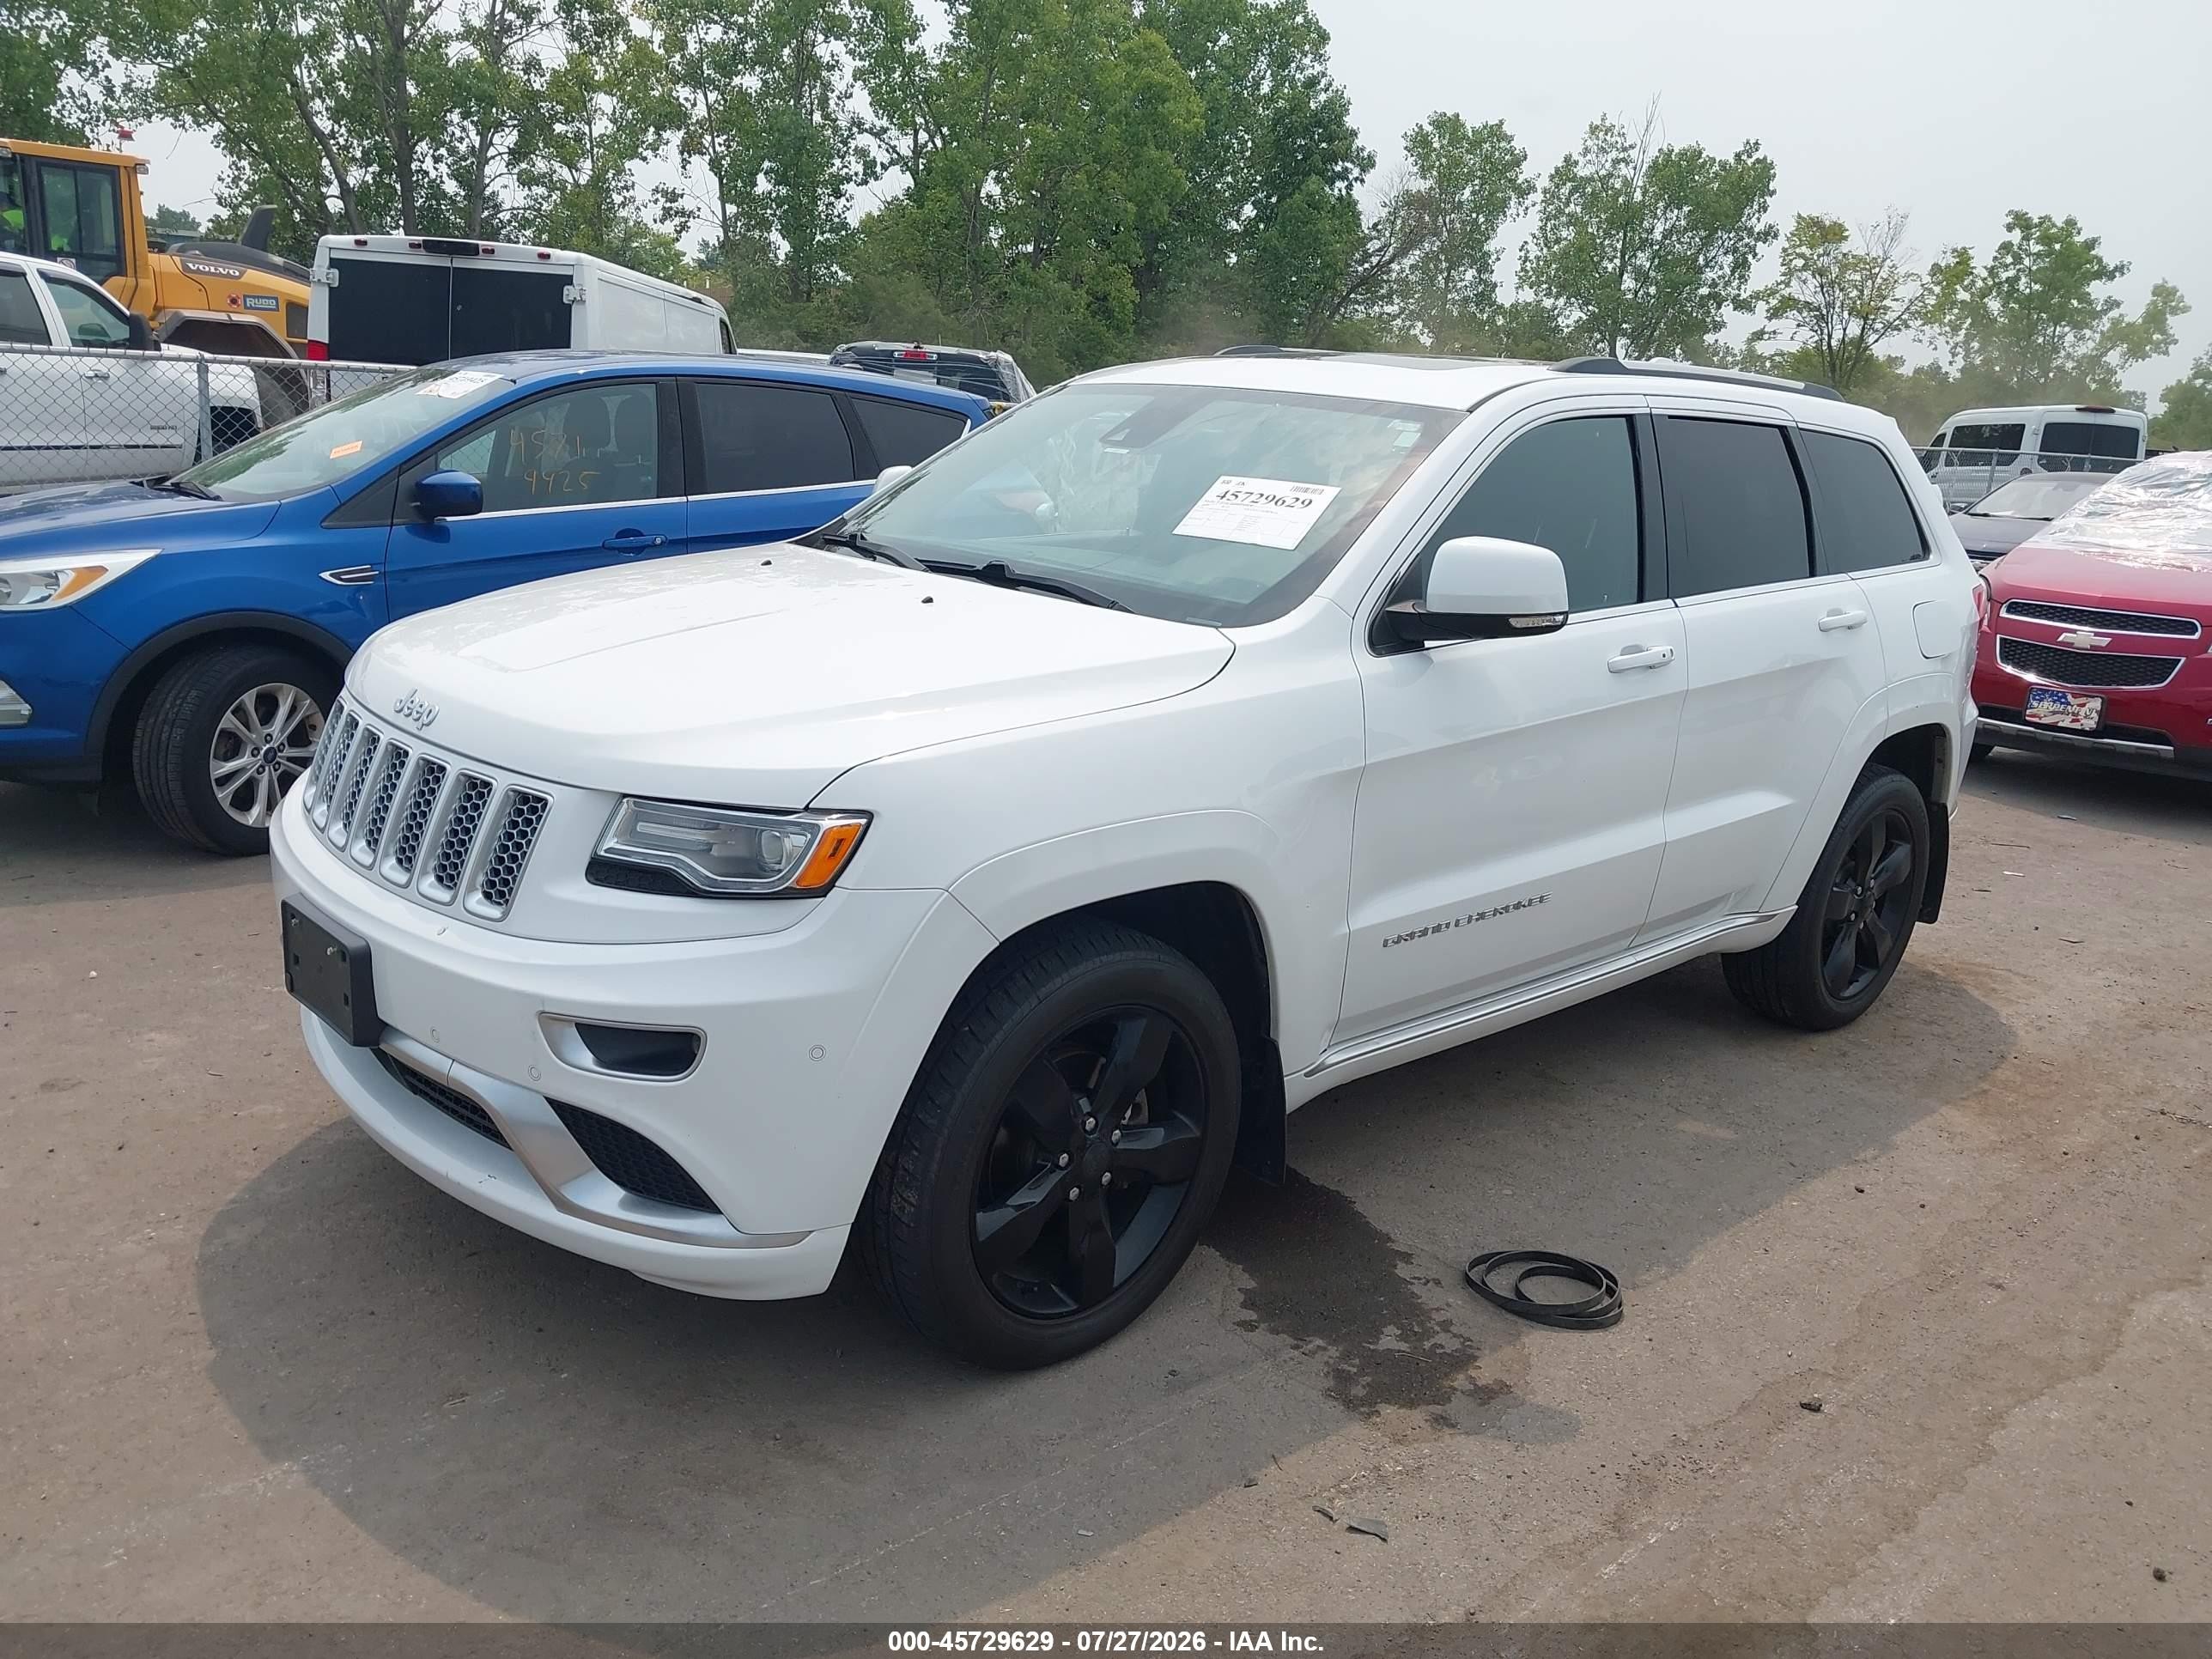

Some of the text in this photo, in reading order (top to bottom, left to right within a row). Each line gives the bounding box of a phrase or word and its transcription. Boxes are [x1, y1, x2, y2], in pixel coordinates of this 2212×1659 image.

[185, 262, 240, 276] VOLVO
[246, 298, 276, 307] RUDD
[1216, 489, 1313, 510] 45729629
[392, 688, 441, 731] Jeep
[1382, 890, 1553, 948] GRAND CHEROKEE
